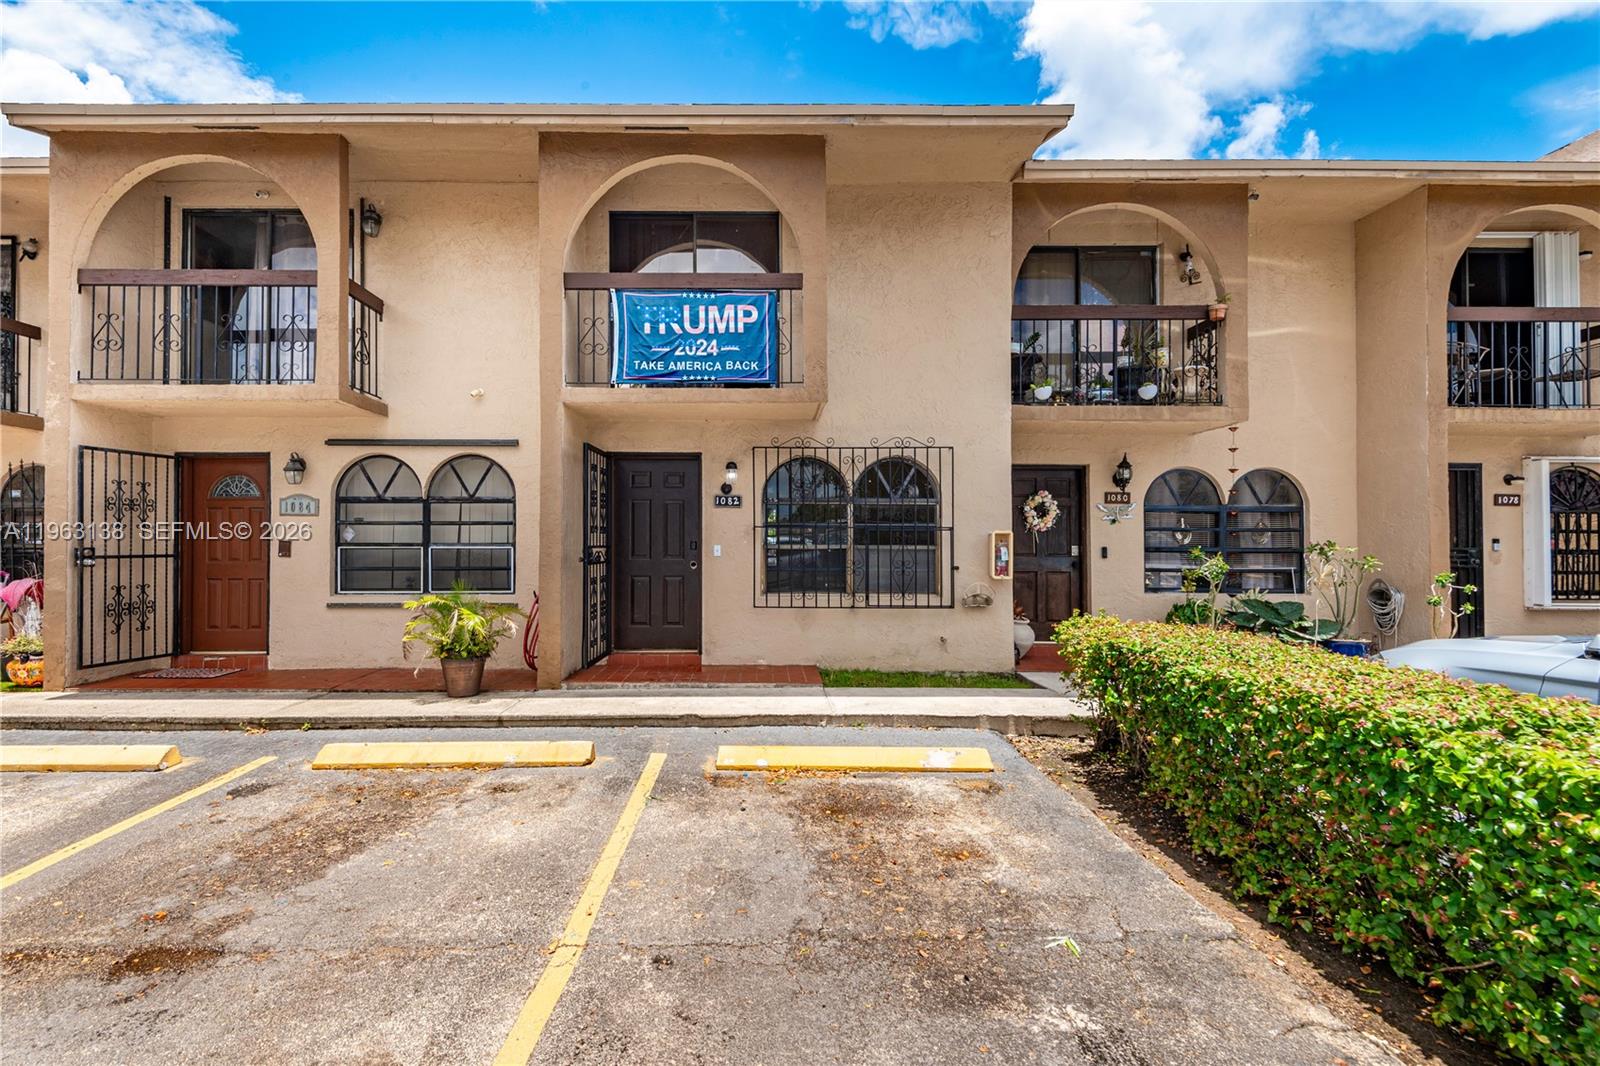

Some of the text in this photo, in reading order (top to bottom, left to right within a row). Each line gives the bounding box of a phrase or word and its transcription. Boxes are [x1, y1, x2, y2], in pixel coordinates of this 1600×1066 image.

[636, 304, 759, 335] TRUMP
[674, 339, 719, 356] 2024
[633, 360, 759, 371] TAKE AMERICA BACK
[715, 496, 740, 505] 1082
[1107, 494, 1129, 502] 1080
[1498, 496, 1519, 504] 1078
[285, 501, 312, 513] 1084
